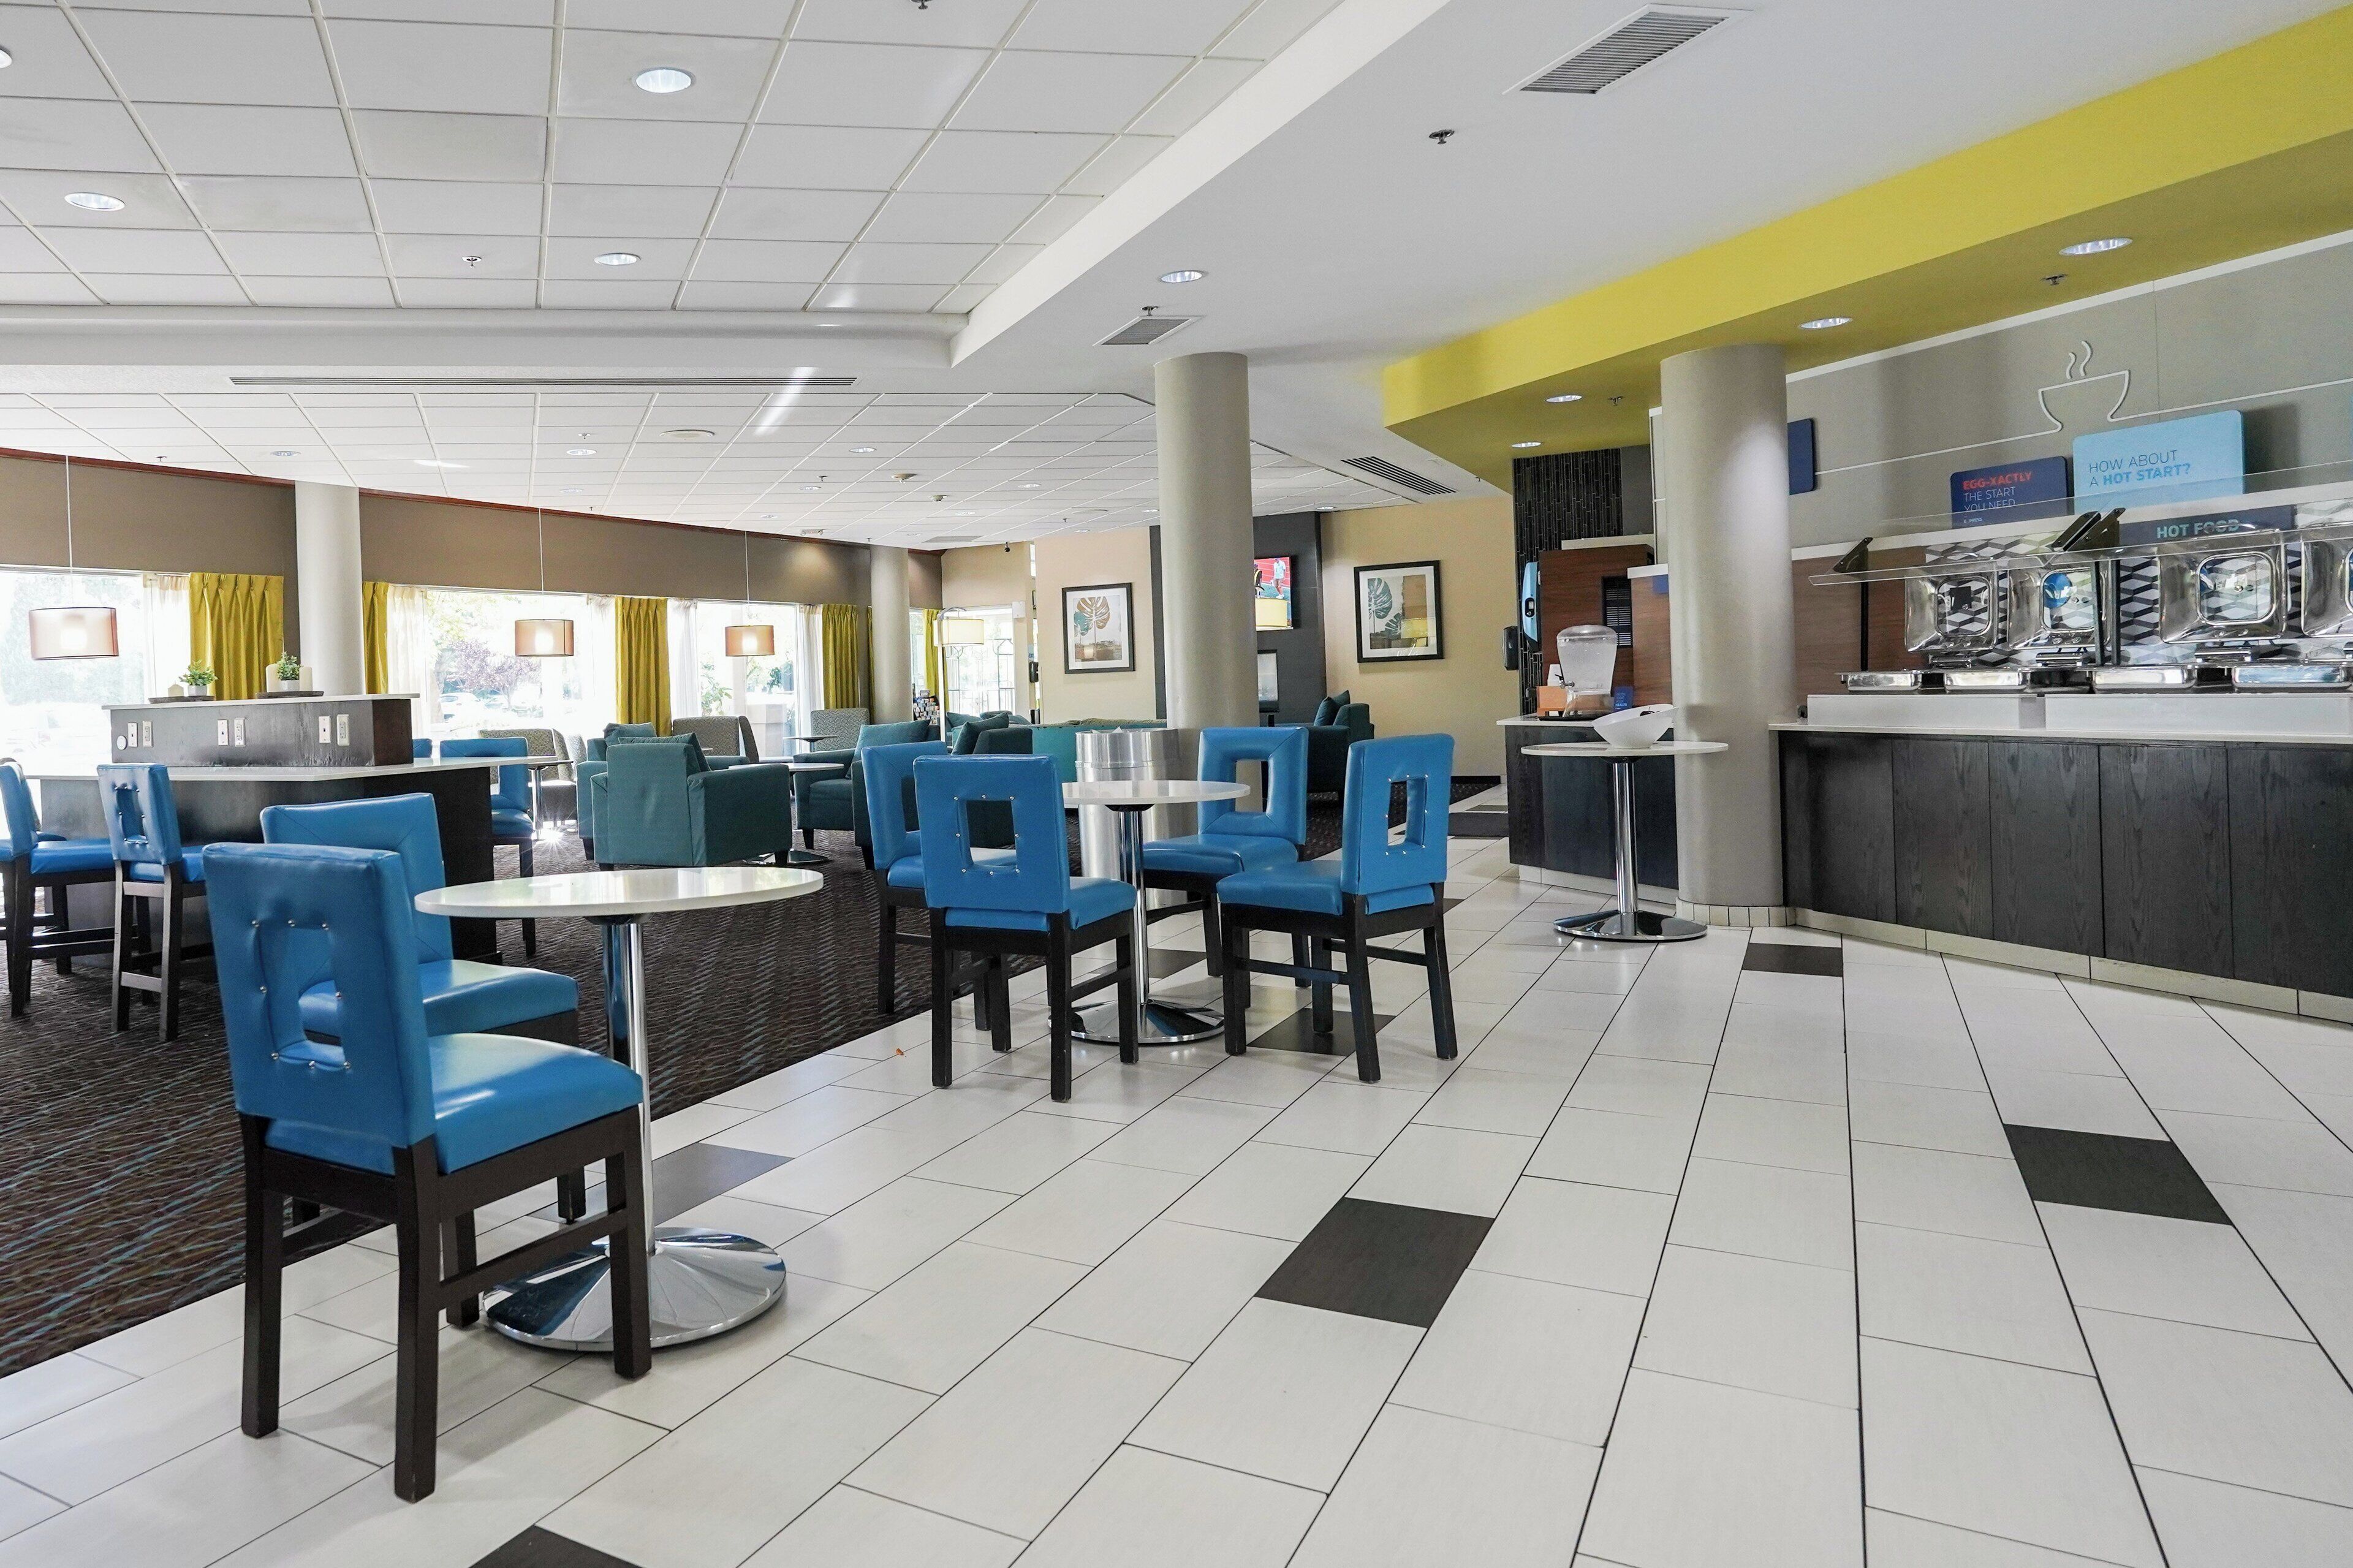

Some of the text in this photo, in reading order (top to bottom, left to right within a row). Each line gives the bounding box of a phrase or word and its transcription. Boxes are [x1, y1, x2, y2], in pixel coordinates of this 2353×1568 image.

[2090, 450, 2177, 473] HOW ABOUT
[1963, 471, 2032, 490] EGG-XACTLY
[2090, 463, 2191, 487] A HOT START?
[1964, 487, 2015, 502] THE START
[1964, 499, 2015, 511] YOU NEED
[2156, 519, 2239, 538] HOT FOOD
